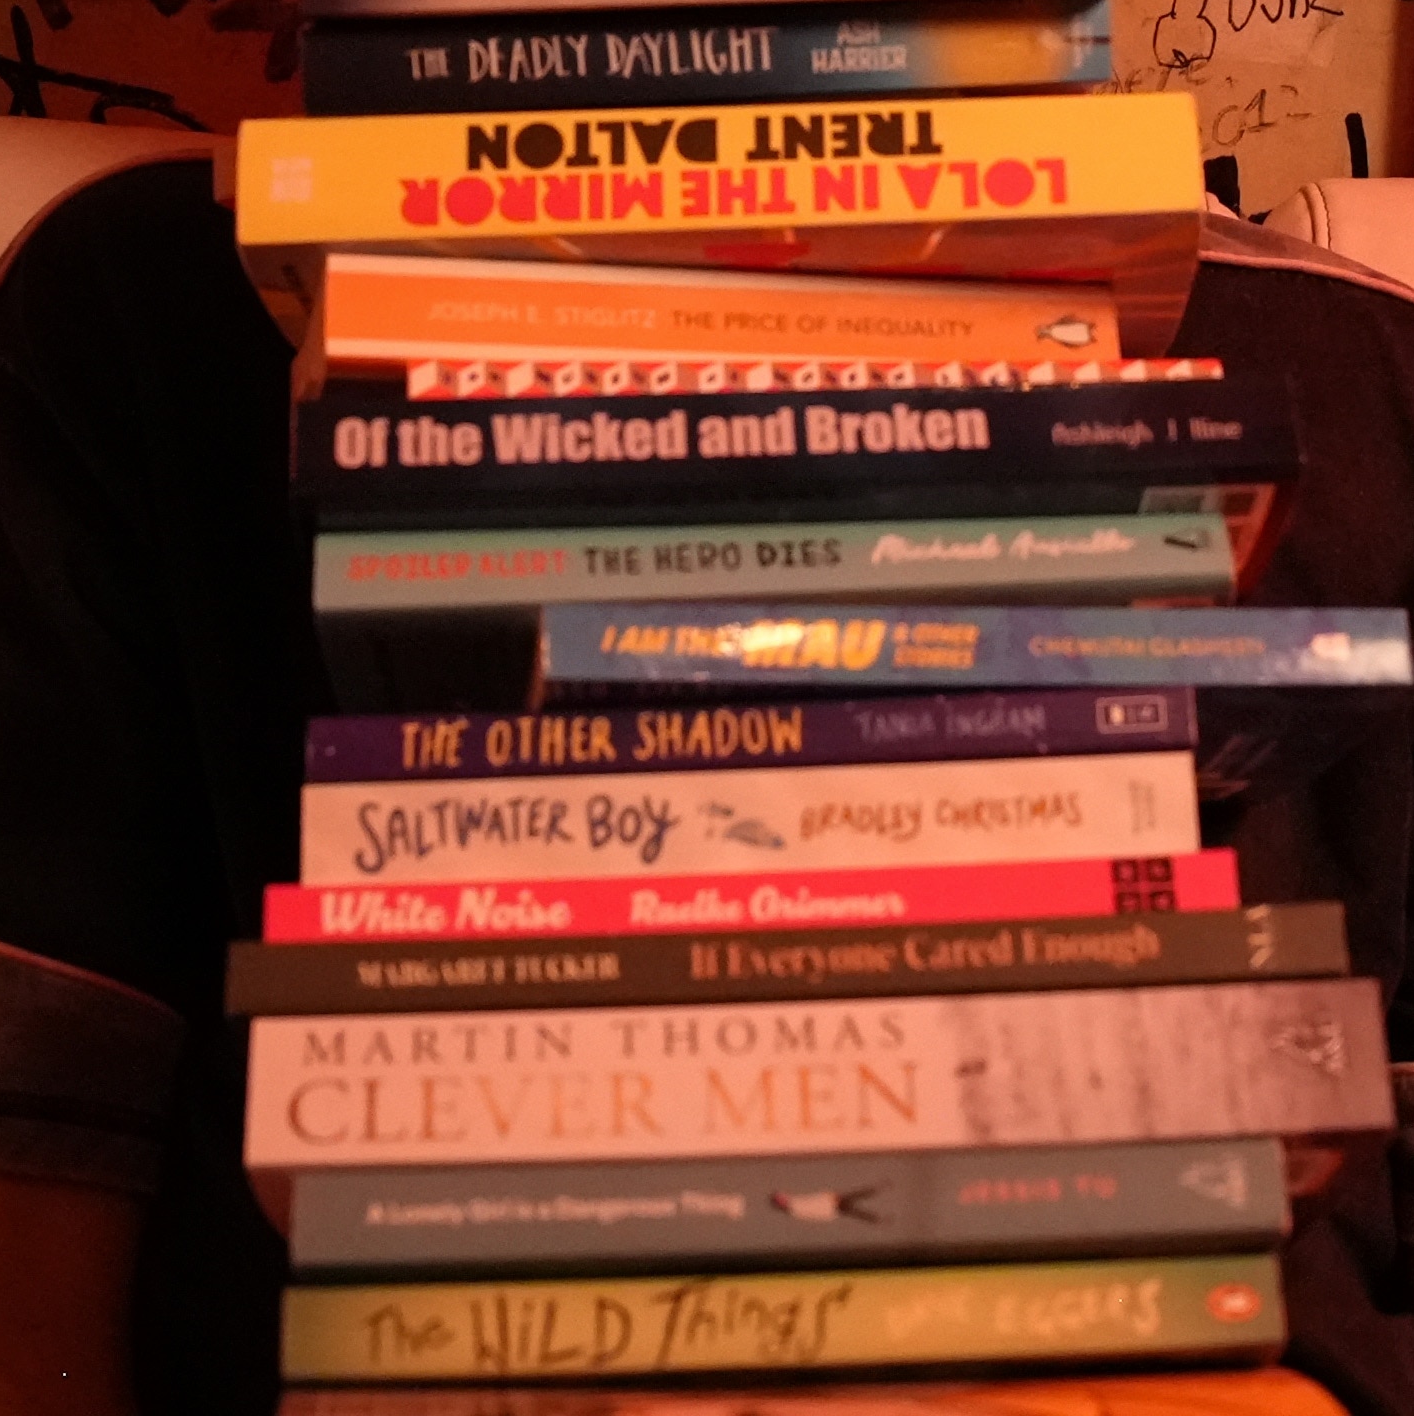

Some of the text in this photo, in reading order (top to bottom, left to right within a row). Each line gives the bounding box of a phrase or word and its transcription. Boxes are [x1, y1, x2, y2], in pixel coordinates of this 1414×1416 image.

[407, 27, 777, 83] THE DEADLY DAYLIGHT
[466, 109, 943, 171] TRENT DALTON
[399, 156, 1069, 228] LOLA IN THE MIRROR
[671, 309, 715, 332] THE
[723, 311, 787, 333] PRICE
[796, 313, 827, 335] OF
[836, 314, 975, 340] INEQUALITY
[335, 415, 390, 469] Of
[398, 413, 484, 465] the
[490, 410, 688, 466] Wicked
[698, 407, 798, 458] and
[805, 404, 990, 455] Broken
[584, 546, 644, 575] THE
[653, 540, 742, 573] HERO
[756, 539, 843, 569] DIES
[400, 717, 470, 771] THE
[486, 714, 618, 768] OTHER
[632, 706, 804, 762] SHADOW
[354, 791, 1082, 875] SALTWATER BOY BRADLEY CHRISTMAS
[318, 888, 446, 934] White
[455, 886, 572, 932] Noise
[726, 936, 895, 986] Everyone
[904, 929, 1013, 972] Cared
[1021, 924, 1161, 970] Enough
[301, 1013, 906, 1068] MARTIN THOMAS
[287, 1060, 920, 1146] CLEVER MEN
